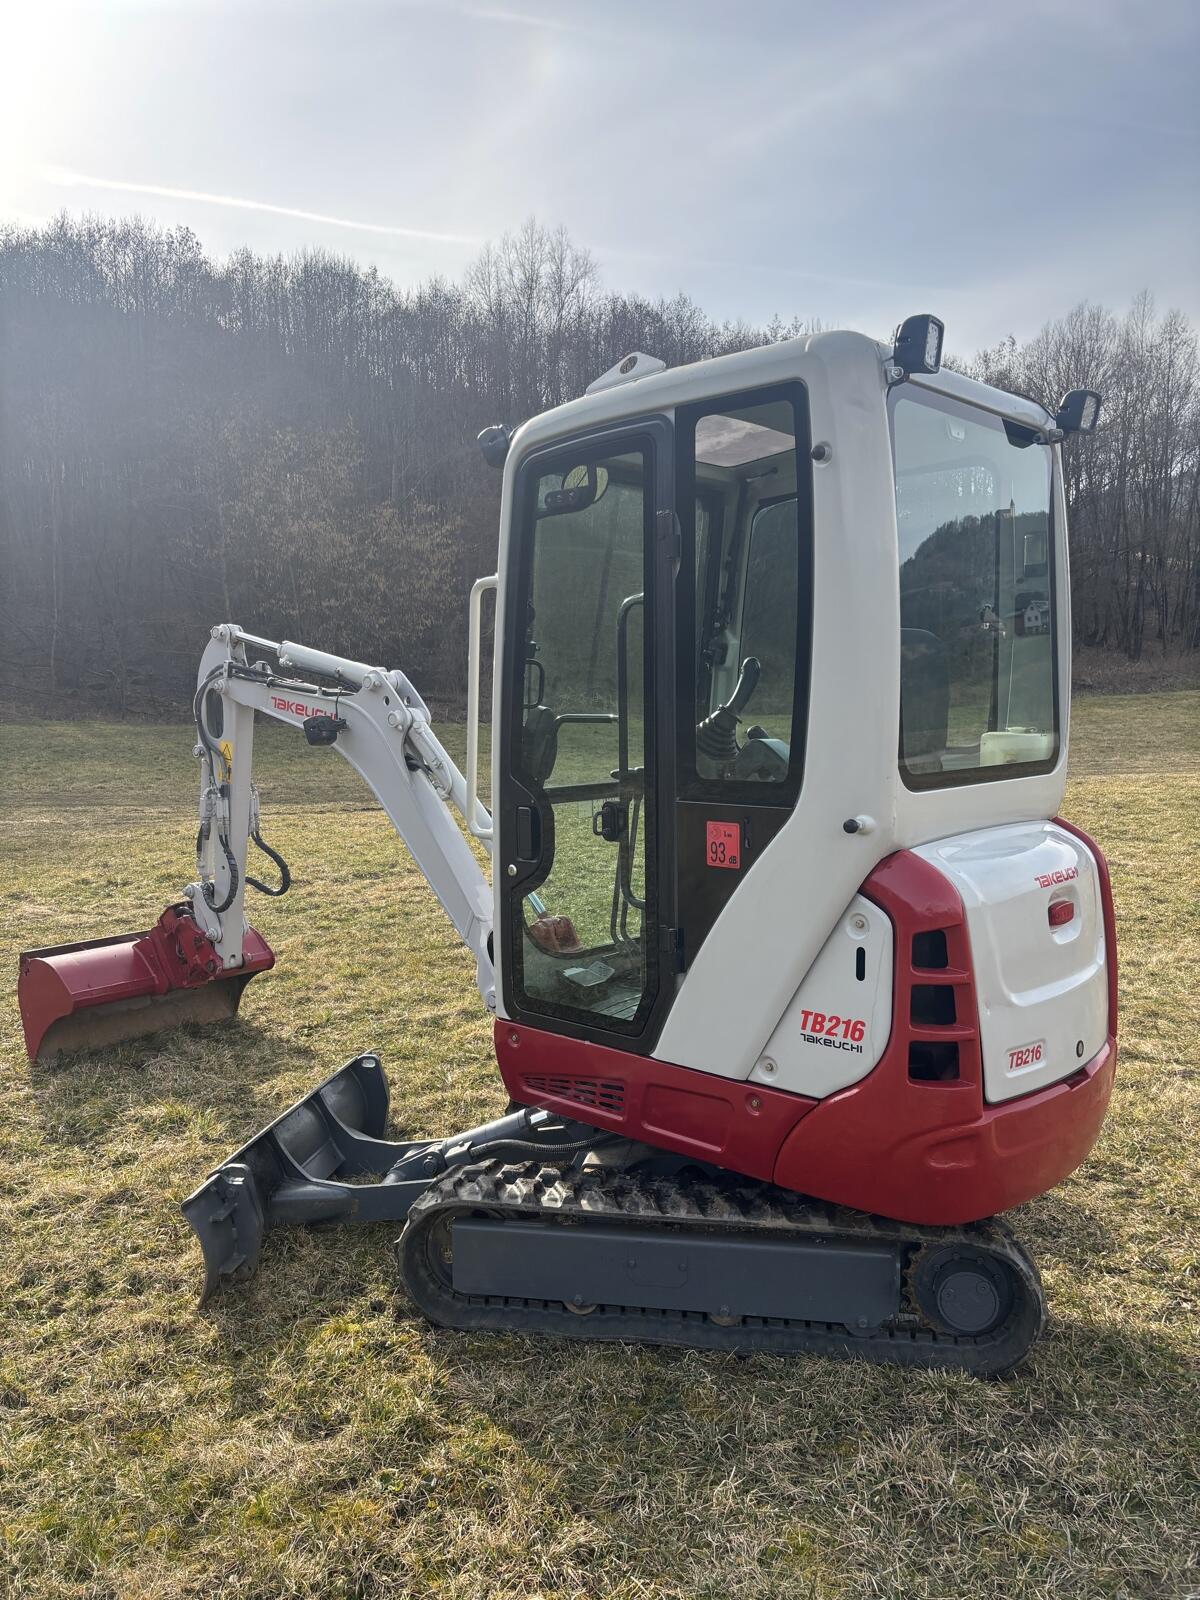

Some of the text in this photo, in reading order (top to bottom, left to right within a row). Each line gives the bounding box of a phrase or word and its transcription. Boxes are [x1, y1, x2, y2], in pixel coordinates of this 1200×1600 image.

[711, 841, 737, 865] 93 dB
[801, 1010, 866, 1042] TB216
[800, 1032, 863, 1053] TAKEUCHI
[1008, 1044, 1042, 1070] TB216
